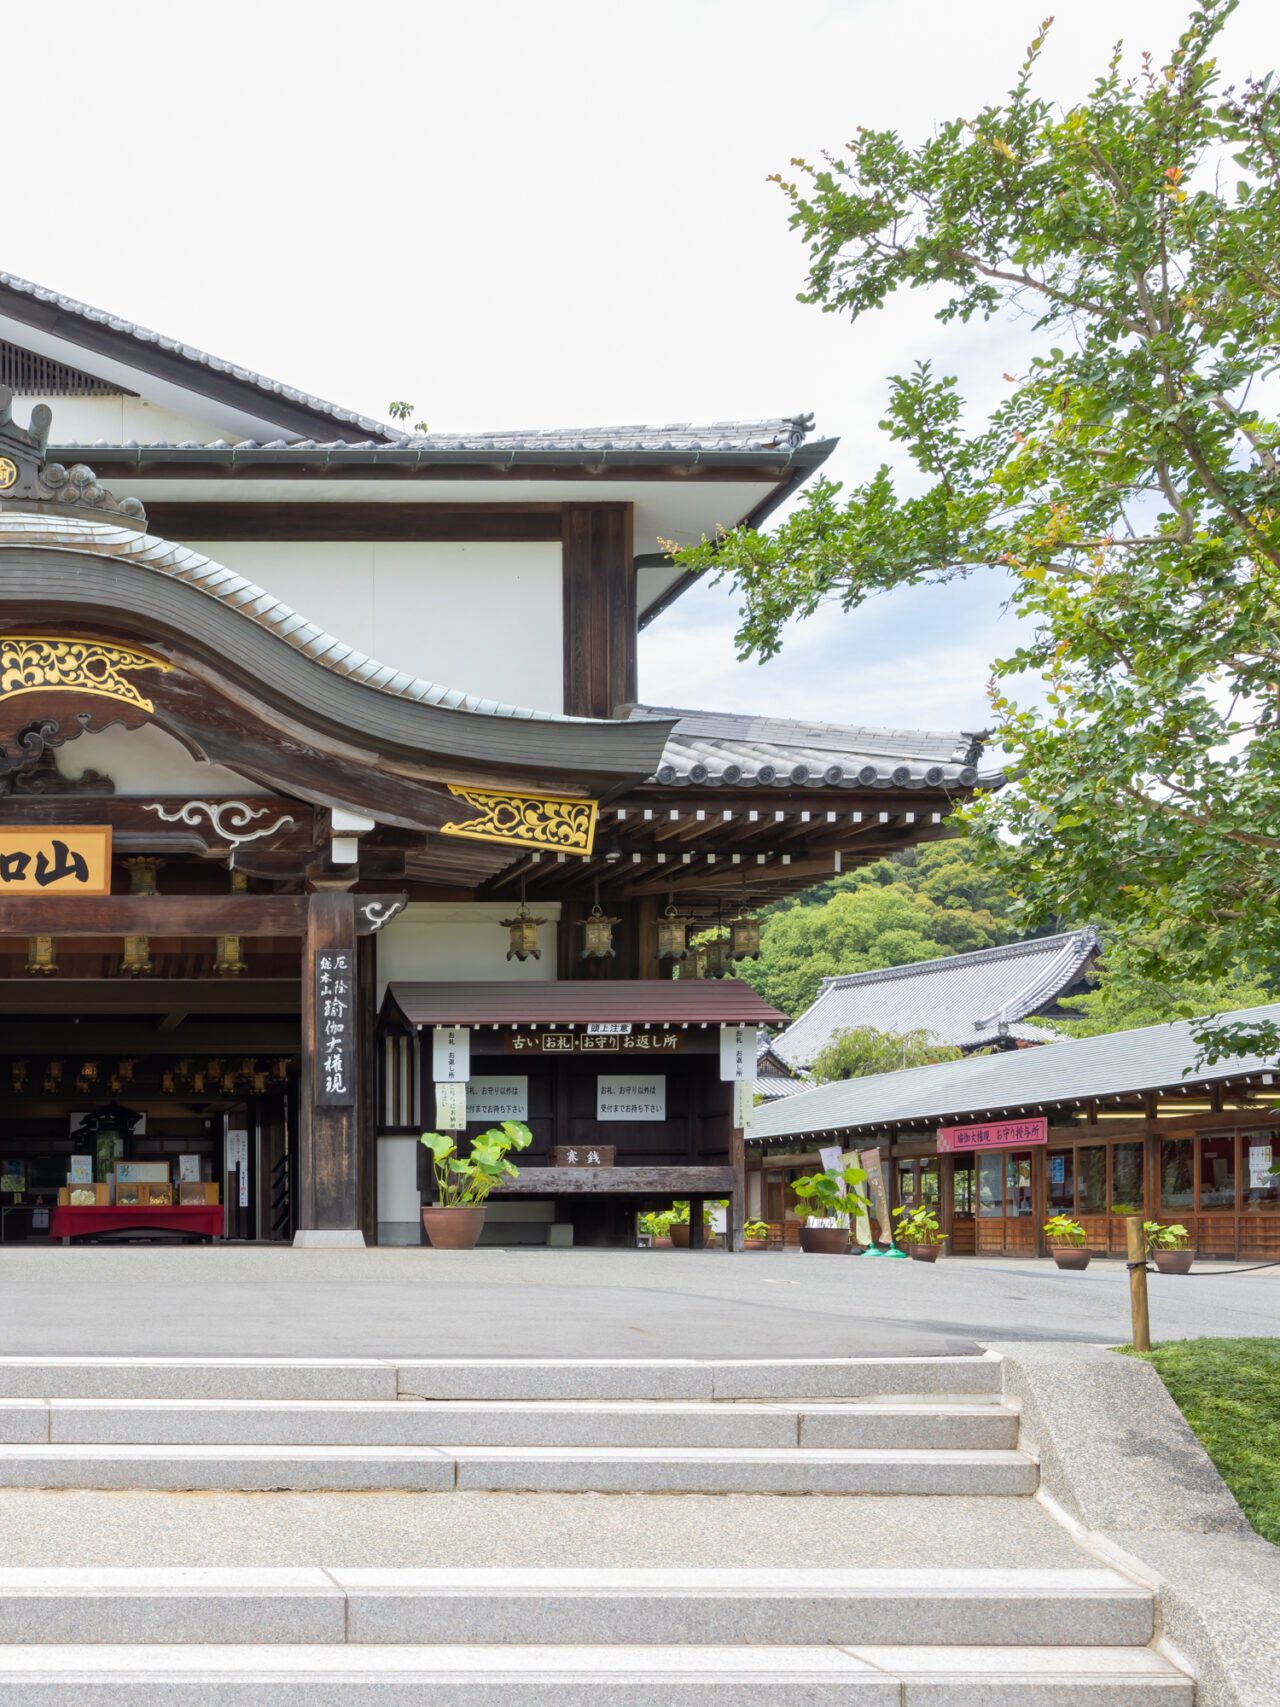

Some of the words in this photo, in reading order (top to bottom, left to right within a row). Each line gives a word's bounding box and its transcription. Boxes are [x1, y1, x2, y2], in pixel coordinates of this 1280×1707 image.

[333, 956, 349, 994] 厄除
[590, 1023, 630, 1033] 頭上注意
[448, 1032, 456, 1045] お札
[448, 1052, 456, 1079] お返し所
